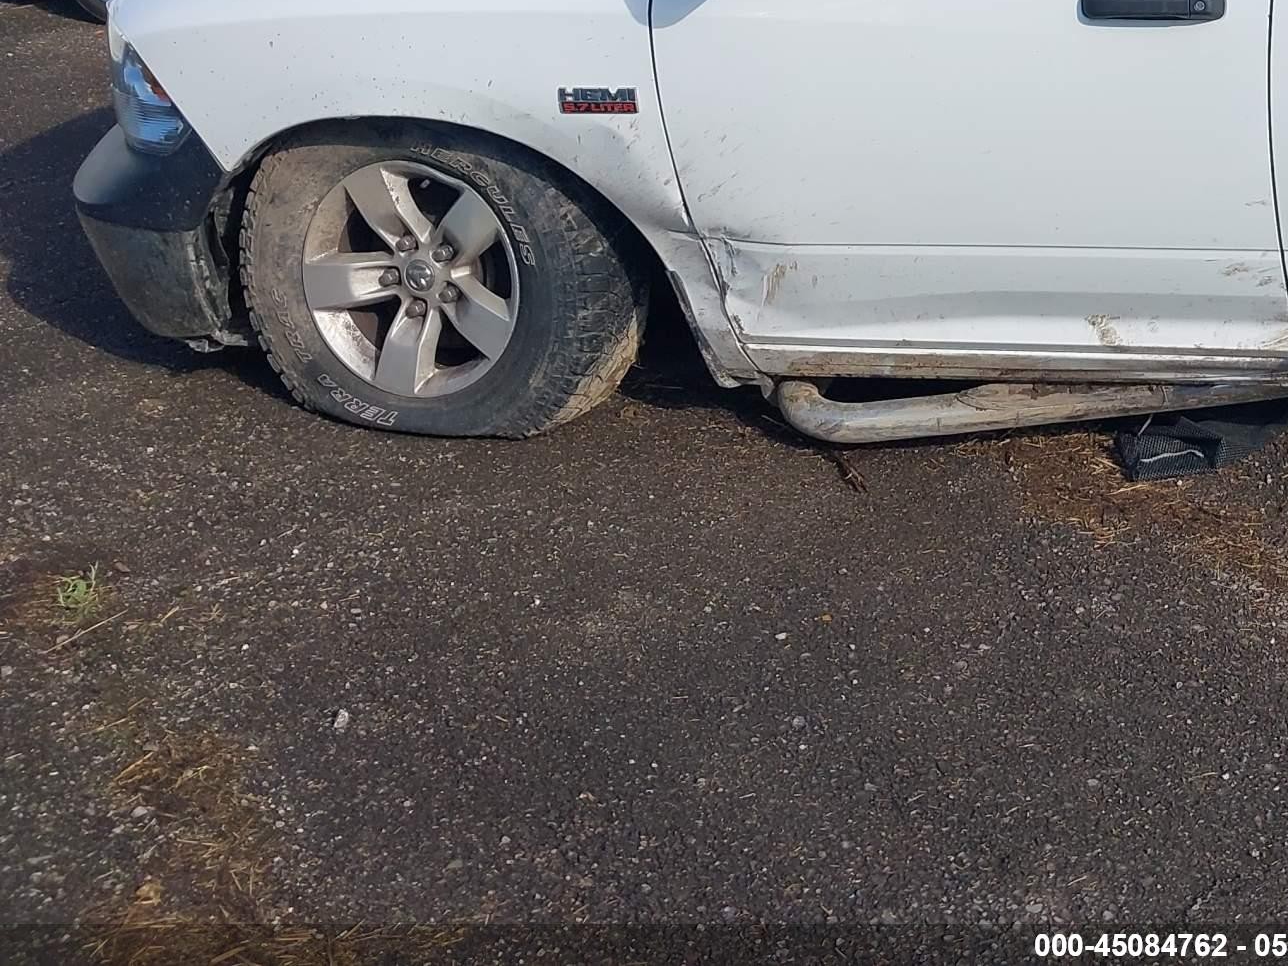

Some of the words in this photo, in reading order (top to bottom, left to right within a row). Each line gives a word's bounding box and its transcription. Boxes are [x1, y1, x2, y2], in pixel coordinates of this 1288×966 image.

[558, 87, 637, 101] HEMI
[591, 103, 635, 112] LITER
[409, 143, 536, 266] HERCULES
[316, 374, 399, 426] TERRA
